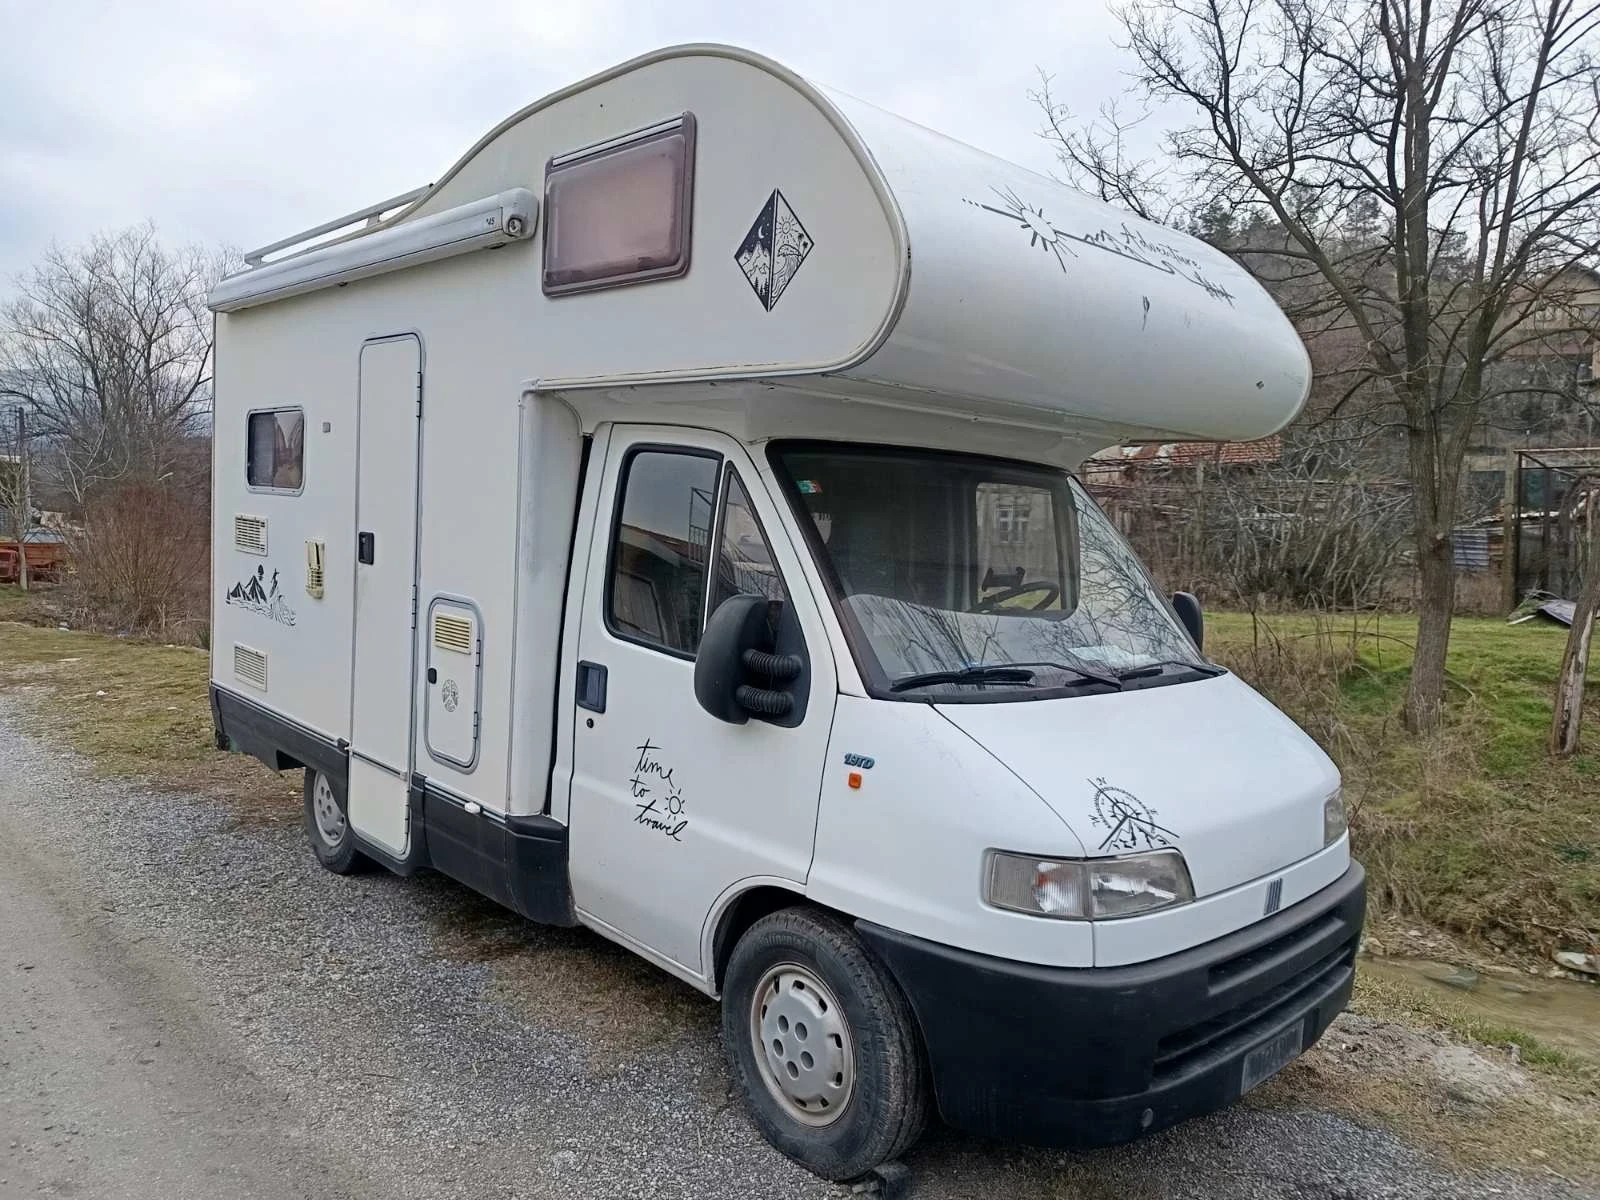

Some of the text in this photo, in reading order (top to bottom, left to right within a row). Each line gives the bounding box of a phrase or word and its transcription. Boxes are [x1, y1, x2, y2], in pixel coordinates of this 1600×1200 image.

[635, 738, 675, 789] time
[630, 774, 652, 798] to
[634, 799, 689, 842] travel
